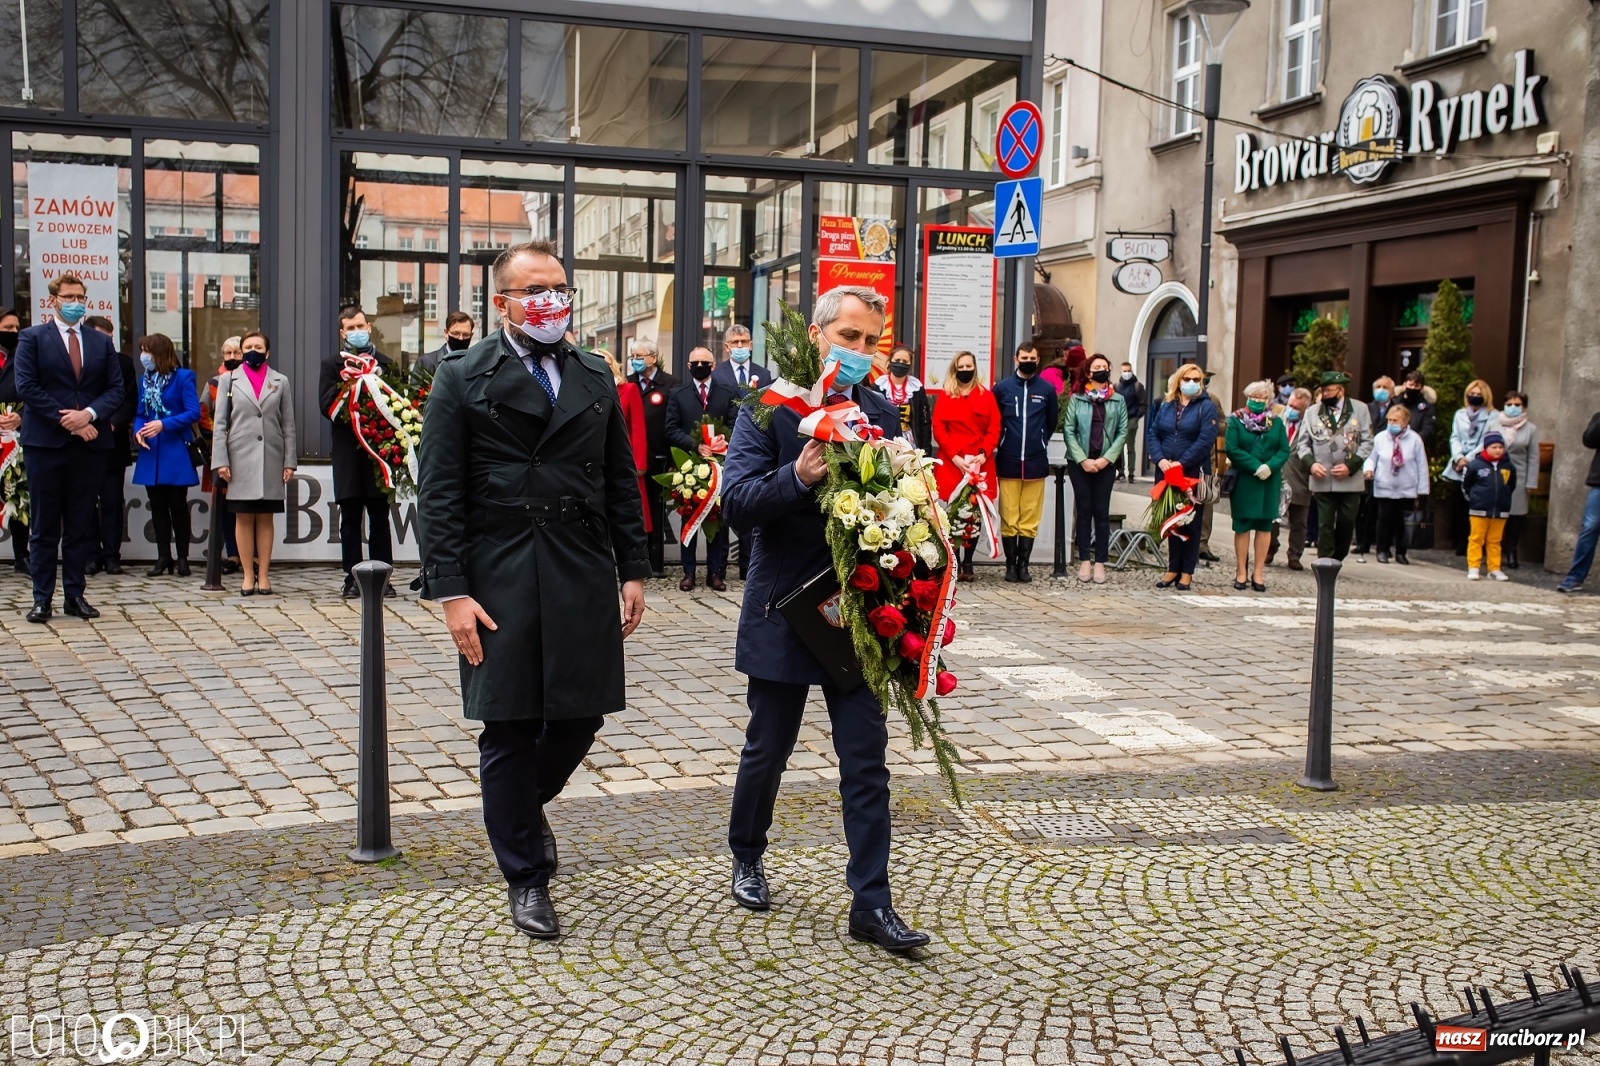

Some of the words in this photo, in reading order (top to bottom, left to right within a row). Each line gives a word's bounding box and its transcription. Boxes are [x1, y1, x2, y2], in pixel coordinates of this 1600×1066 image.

[1233, 129, 1336, 195] Browar
[1408, 49, 1544, 160] Rynek
[33, 196, 115, 218] ZAMÓW
[36, 221, 44, 233] Z
[48, 222, 113, 235] DOWOZEM
[821, 218, 837, 228] Pizza
[837, 219, 853, 229] Time
[821, 230, 840, 242] Druga
[840, 231, 856, 242] pizza
[938, 232, 987, 247] LUNCH
[62, 238, 88, 250] LUB
[829, 241, 852, 254] gratis!
[1124, 241, 1158, 256] BUTIK
[42, 253, 109, 266] ODBIOREM
[42, 268, 54, 279] W
[829, 262, 887, 284] Promocja
[98, 300, 113, 310] 84
